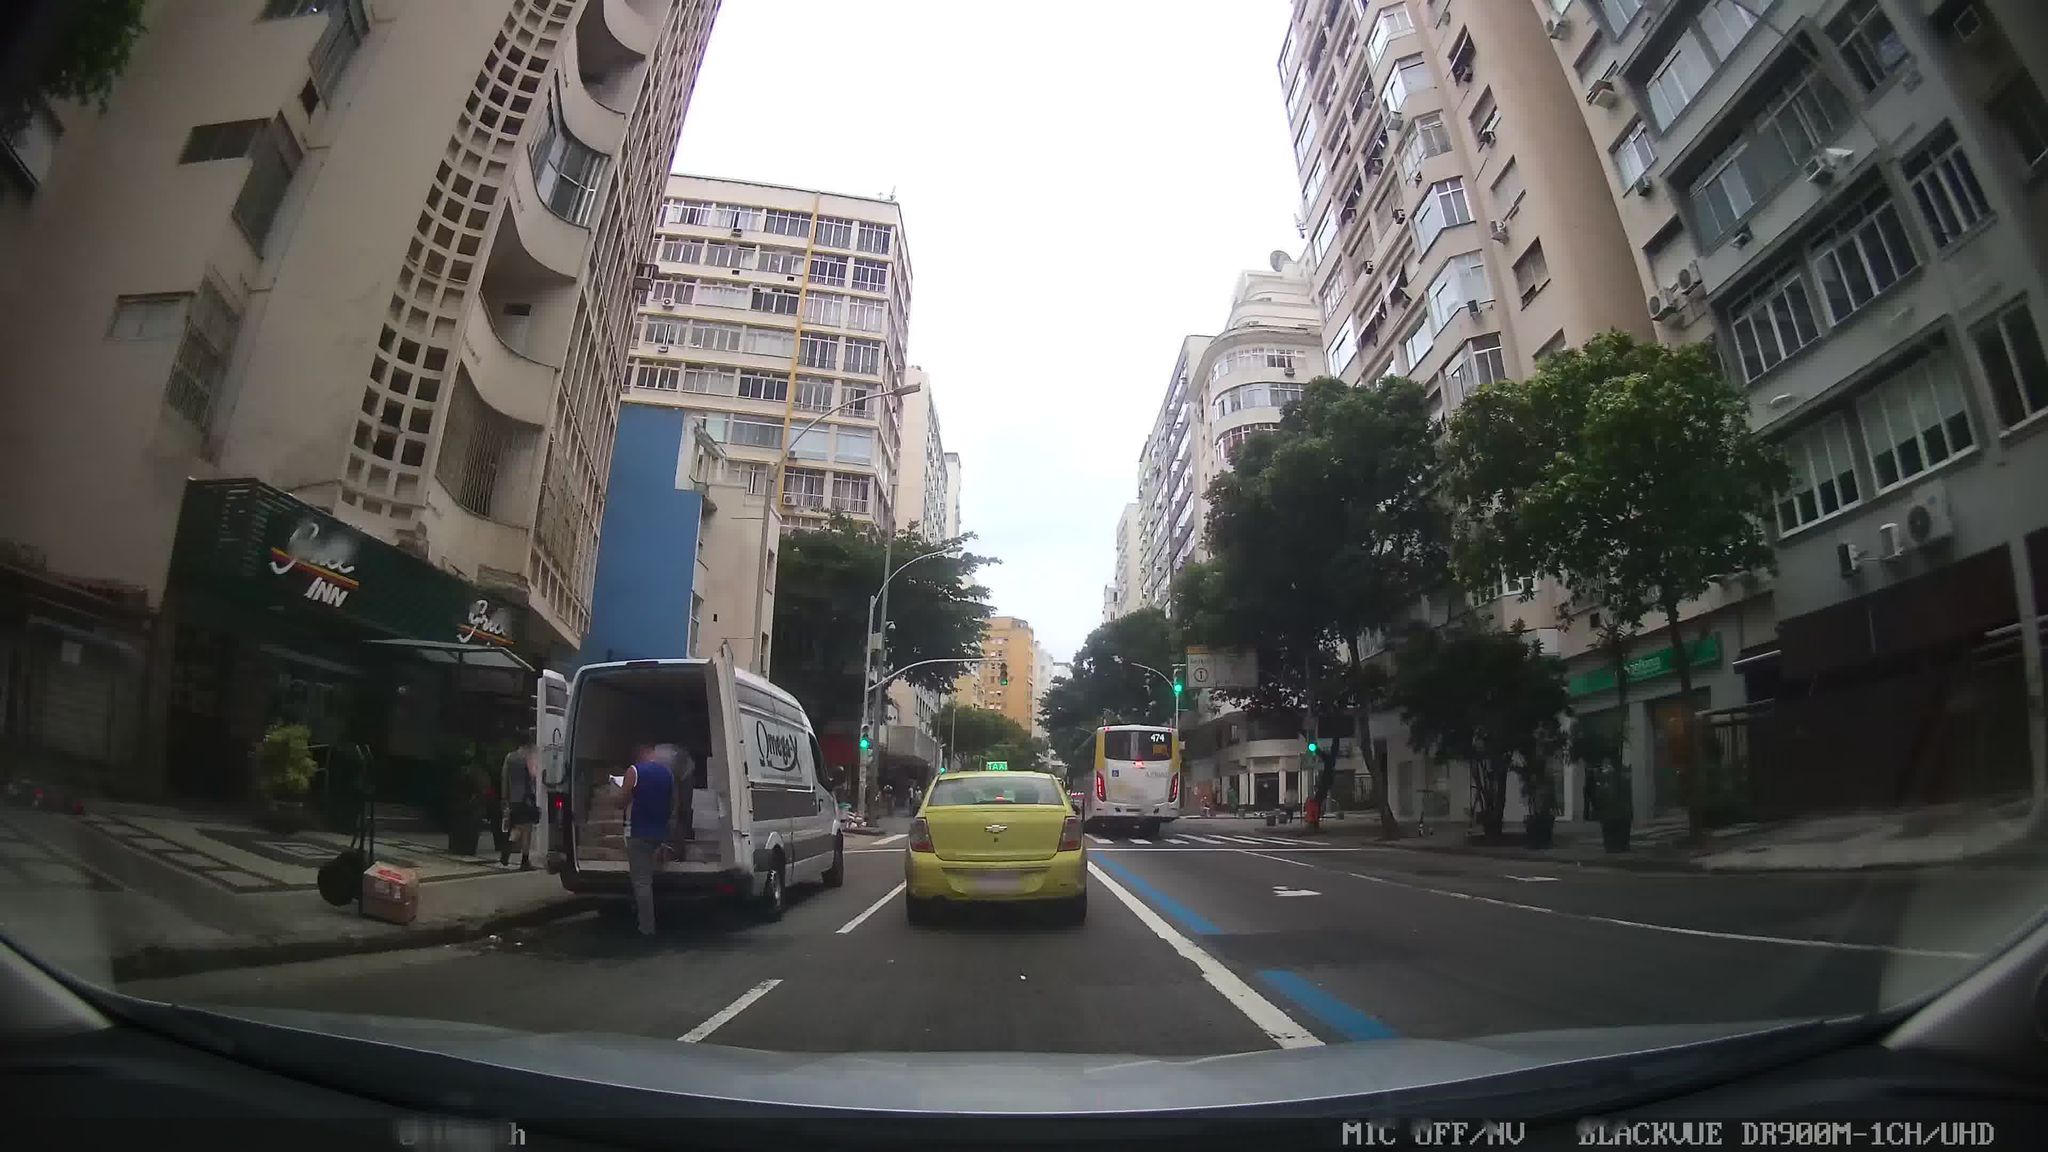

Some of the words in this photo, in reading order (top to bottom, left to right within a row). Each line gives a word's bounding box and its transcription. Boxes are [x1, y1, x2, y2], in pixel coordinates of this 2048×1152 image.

[304, 577, 349, 607] INN
[1150, 733, 1165, 742] 474
[985, 761, 1008, 770] TAXI
